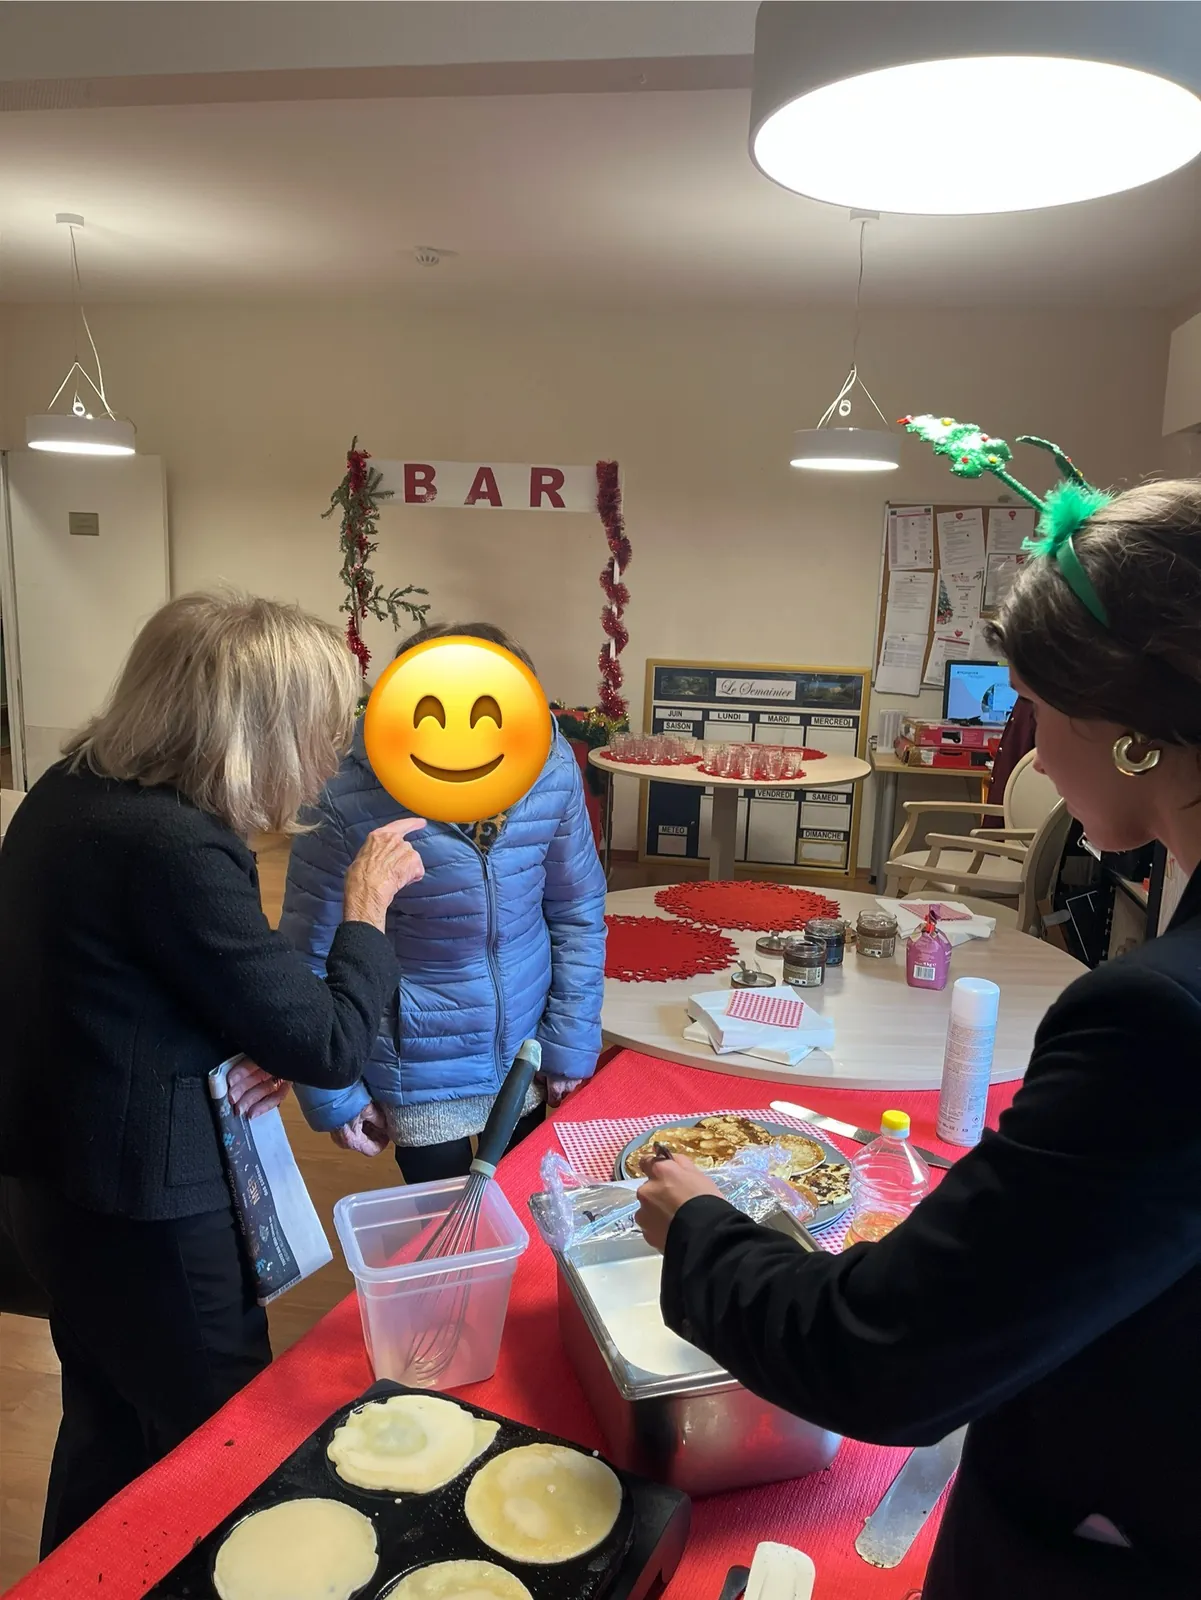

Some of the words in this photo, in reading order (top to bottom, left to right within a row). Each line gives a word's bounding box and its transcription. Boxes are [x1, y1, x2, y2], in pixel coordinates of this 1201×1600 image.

[404, 463, 566, 508] BAR
[719, 680, 736, 695] Le
[739, 680, 792, 697] Semainier
[717, 712, 741, 720] LUNDI
[768, 715, 790, 723] MARDI
[666, 722, 691, 730] SAISON
[814, 717, 851, 726] MERCREDI
[757, 790, 792, 799] VENDREDI
[812, 793, 839, 802] SAMEDI
[805, 831, 841, 840] DIMANCHE
